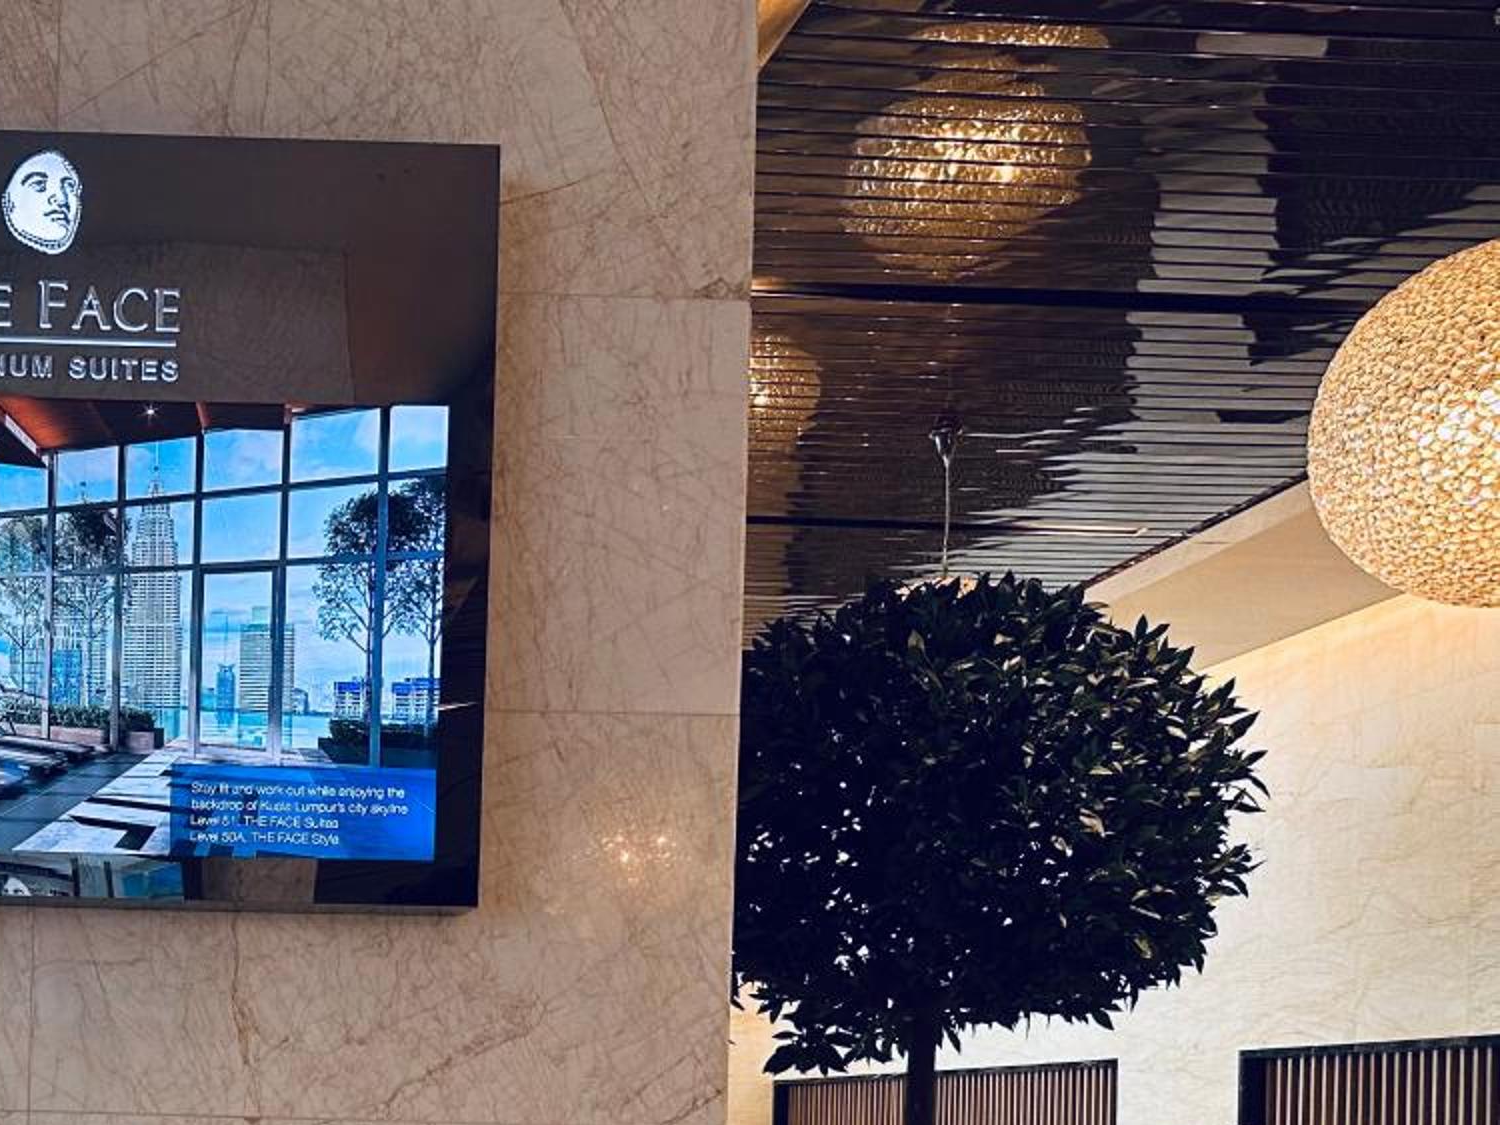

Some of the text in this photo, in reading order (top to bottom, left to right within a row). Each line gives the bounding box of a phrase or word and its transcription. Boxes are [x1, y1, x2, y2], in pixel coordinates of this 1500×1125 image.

[38, 280, 181, 332] FACE
[68, 357, 179, 382] SUITES
[191, 780, 217, 796] Stay
[232, 782, 253, 795] and
[256, 784, 283, 796] work
[285, 784, 306, 797] out
[307, 785, 336, 797] while
[338, 786, 385, 800] enjoying
[387, 786, 405, 799] the
[191, 798, 409, 817] backdrop of Kuala Lumpur's city skyline
[190, 813, 219, 827] Level
[243, 815, 267, 828] THE
[269, 816, 302, 829] FACE
[189, 830, 219, 843] Level
[251, 831, 275, 844] THE
[277, 832, 309, 845] FACE
[311, 832, 340, 847] Style
